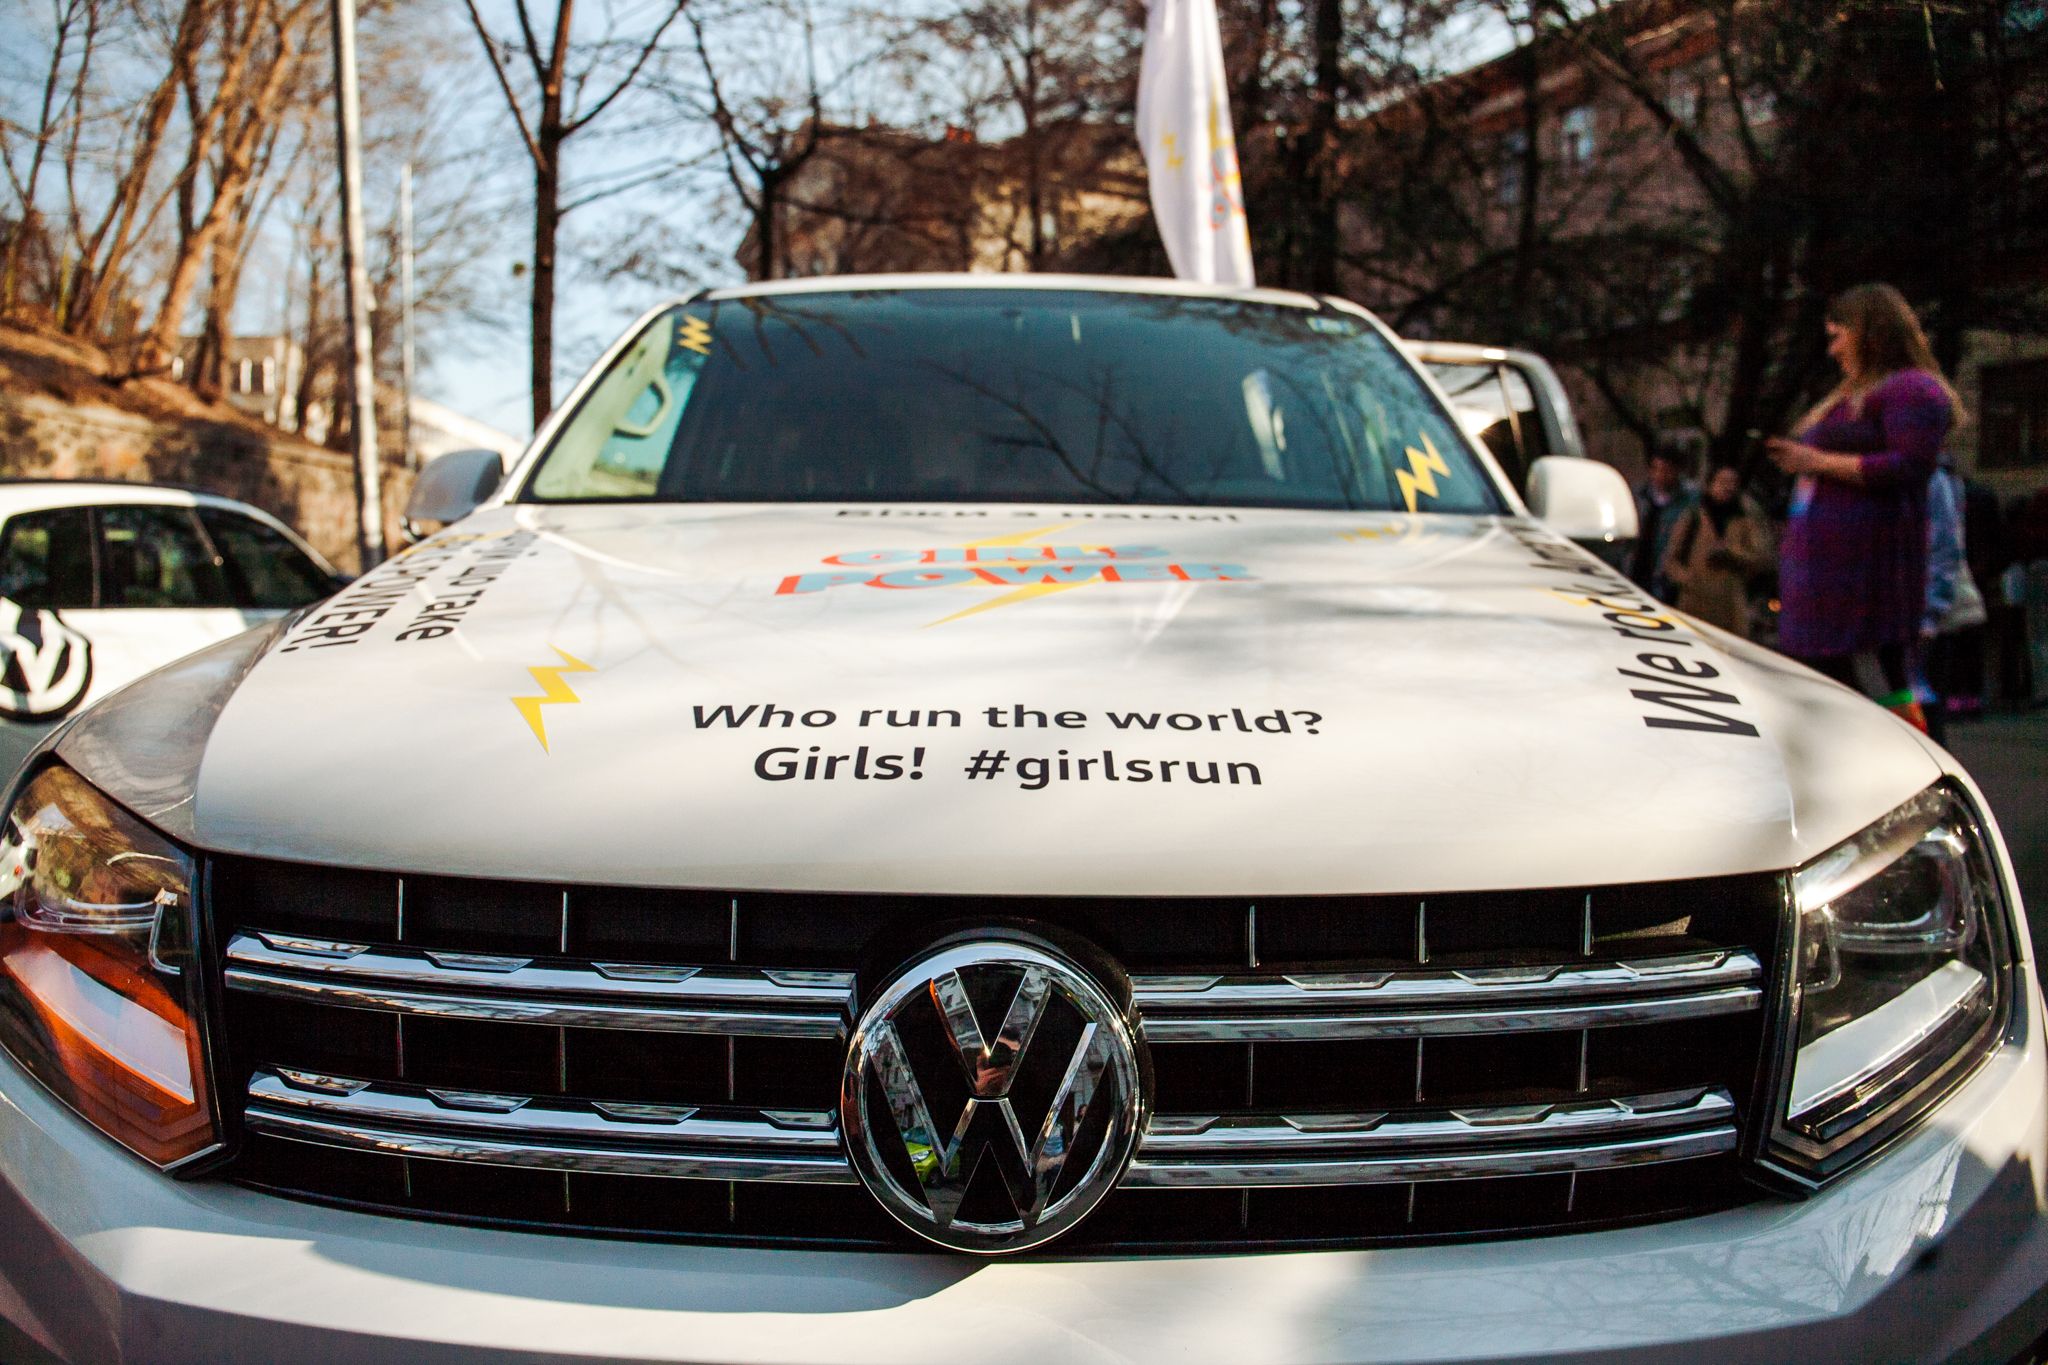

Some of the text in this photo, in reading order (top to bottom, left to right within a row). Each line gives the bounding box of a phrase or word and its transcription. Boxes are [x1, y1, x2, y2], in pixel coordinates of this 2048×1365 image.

[821, 544, 1170, 567] GIRLS
[774, 562, 1262, 596] POWER
[1616, 652, 1761, 738] We
[692, 703, 1323, 735] Who run the world?
[754, 745, 1262, 790] Girls! #girlsrun
[853, 953, 1130, 1243] VW
